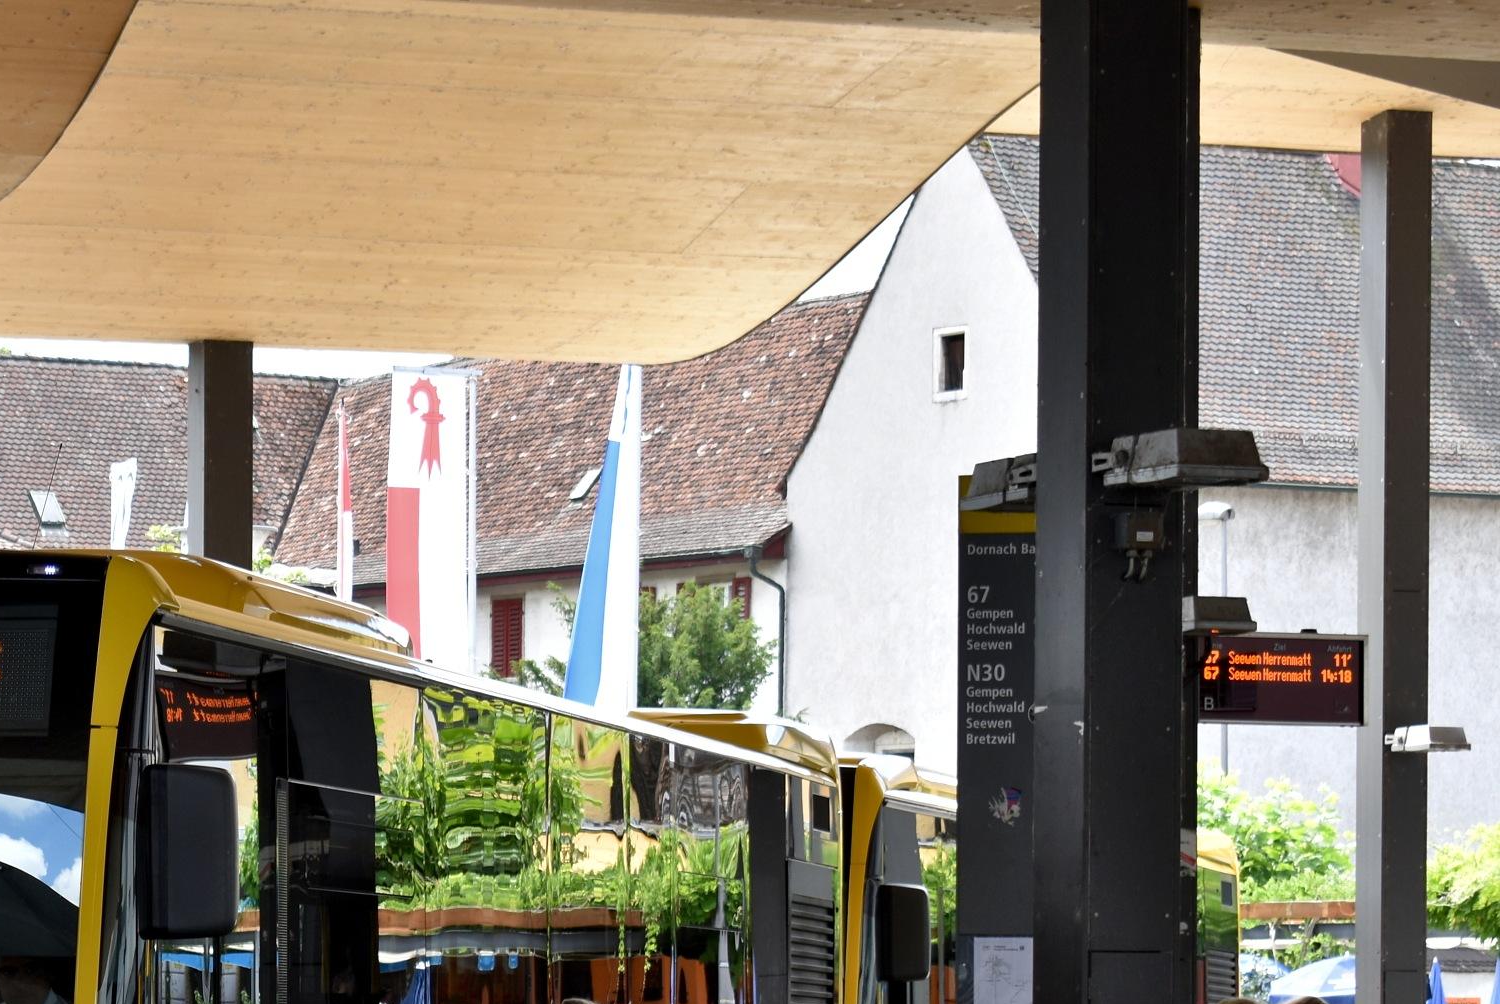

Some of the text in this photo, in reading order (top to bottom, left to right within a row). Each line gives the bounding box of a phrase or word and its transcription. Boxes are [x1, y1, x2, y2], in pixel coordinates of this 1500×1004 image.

[967, 543, 1036, 555] Dornach Ba
[967, 585, 990, 603] 67
[966, 608, 1013, 621] Gempen
[966, 622, 1025, 635] Hochwald
[966, 639, 1012, 650] Seewen
[1228, 650, 1261, 665] Seewen
[1263, 651, 1311, 666] Herrenmatt
[967, 664, 1005, 681] N30
[1204, 666, 1352, 683] 67 Seewen Herrenmatt 14:18
[966, 686, 1013, 700] Gempen
[966, 701, 1025, 713] Hochwald
[1204, 697, 1214, 710] B
[966, 718, 1012, 729] Seewen
[966, 732, 1015, 744] Bretzwil
